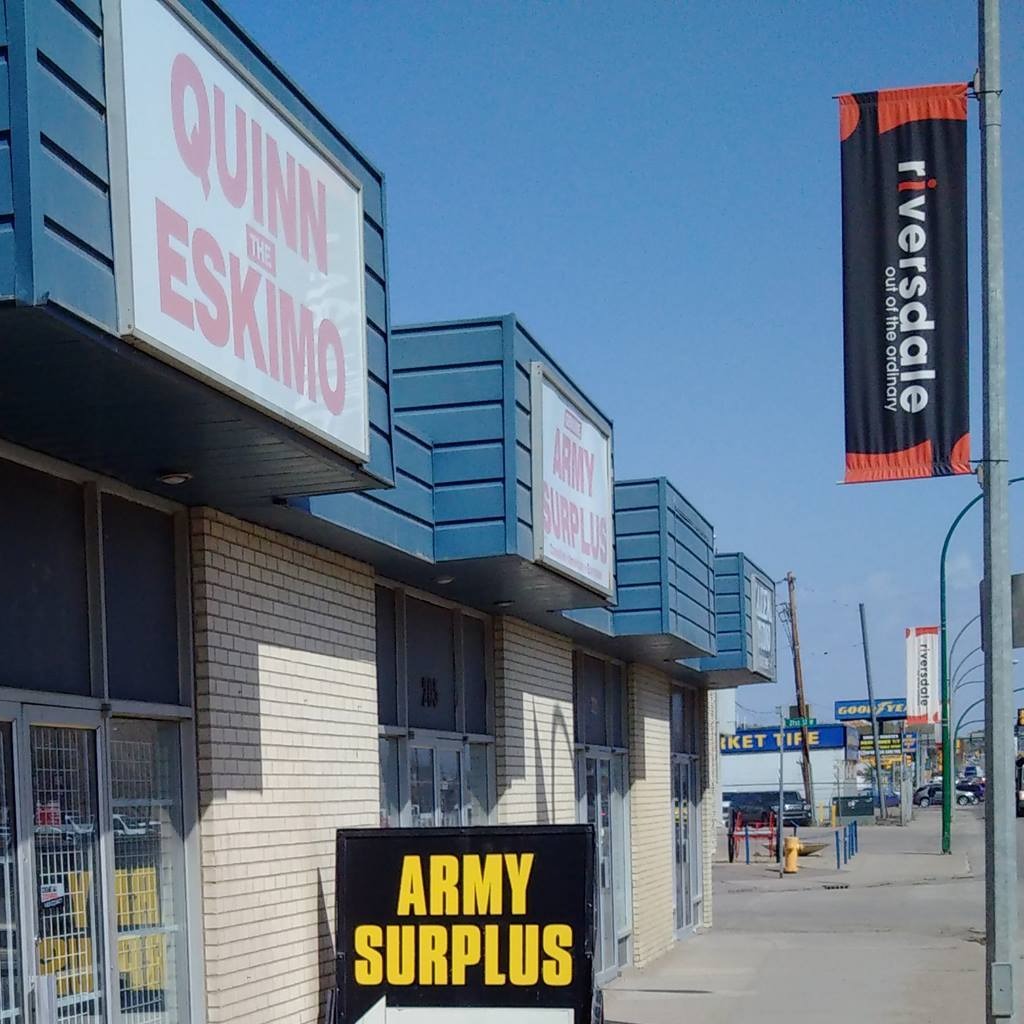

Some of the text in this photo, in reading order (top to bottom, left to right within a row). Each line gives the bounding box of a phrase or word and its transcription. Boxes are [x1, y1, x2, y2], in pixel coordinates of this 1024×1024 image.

[171, 53, 328, 276] QUINN
[249, 233, 272, 268] THE
[897, 160, 937, 414] riversdale
[155, 197, 346, 416] ESKIMO
[884, 266, 898, 413] out of the ordinary
[552, 428, 595, 498] ARMY
[543, 480, 608, 565] SURPLUS
[919, 643, 930, 707] riversdale
[396, 852, 535, 916] ARMY
[354, 923, 574, 987] SURPLUS
